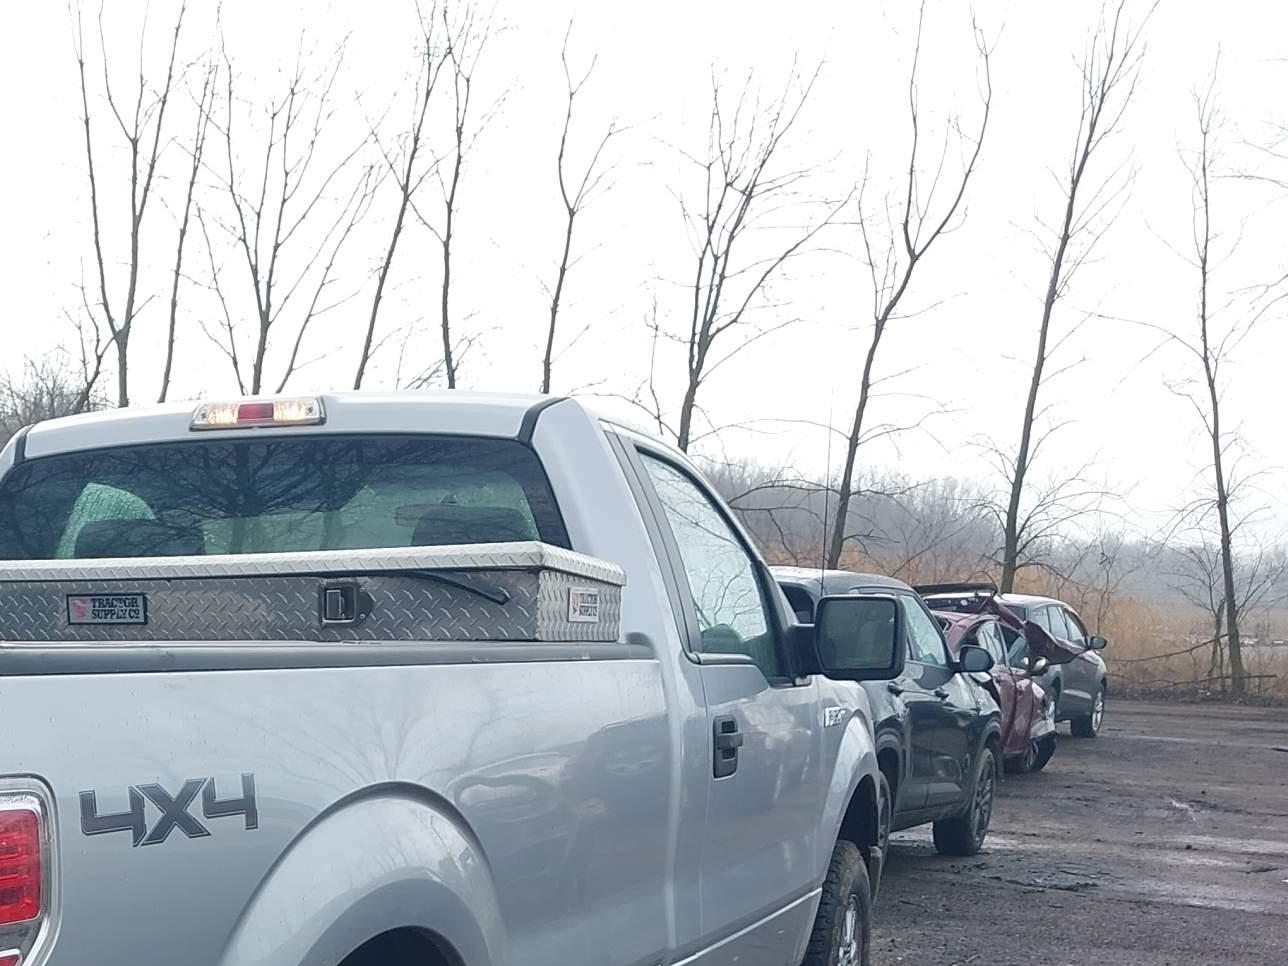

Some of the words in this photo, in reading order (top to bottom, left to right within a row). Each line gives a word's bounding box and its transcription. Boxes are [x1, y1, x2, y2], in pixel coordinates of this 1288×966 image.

[91, 598, 139, 608] TRACTOR
[92, 609, 127, 619] SUPPLY
[79, 773, 258, 847] 4X4
